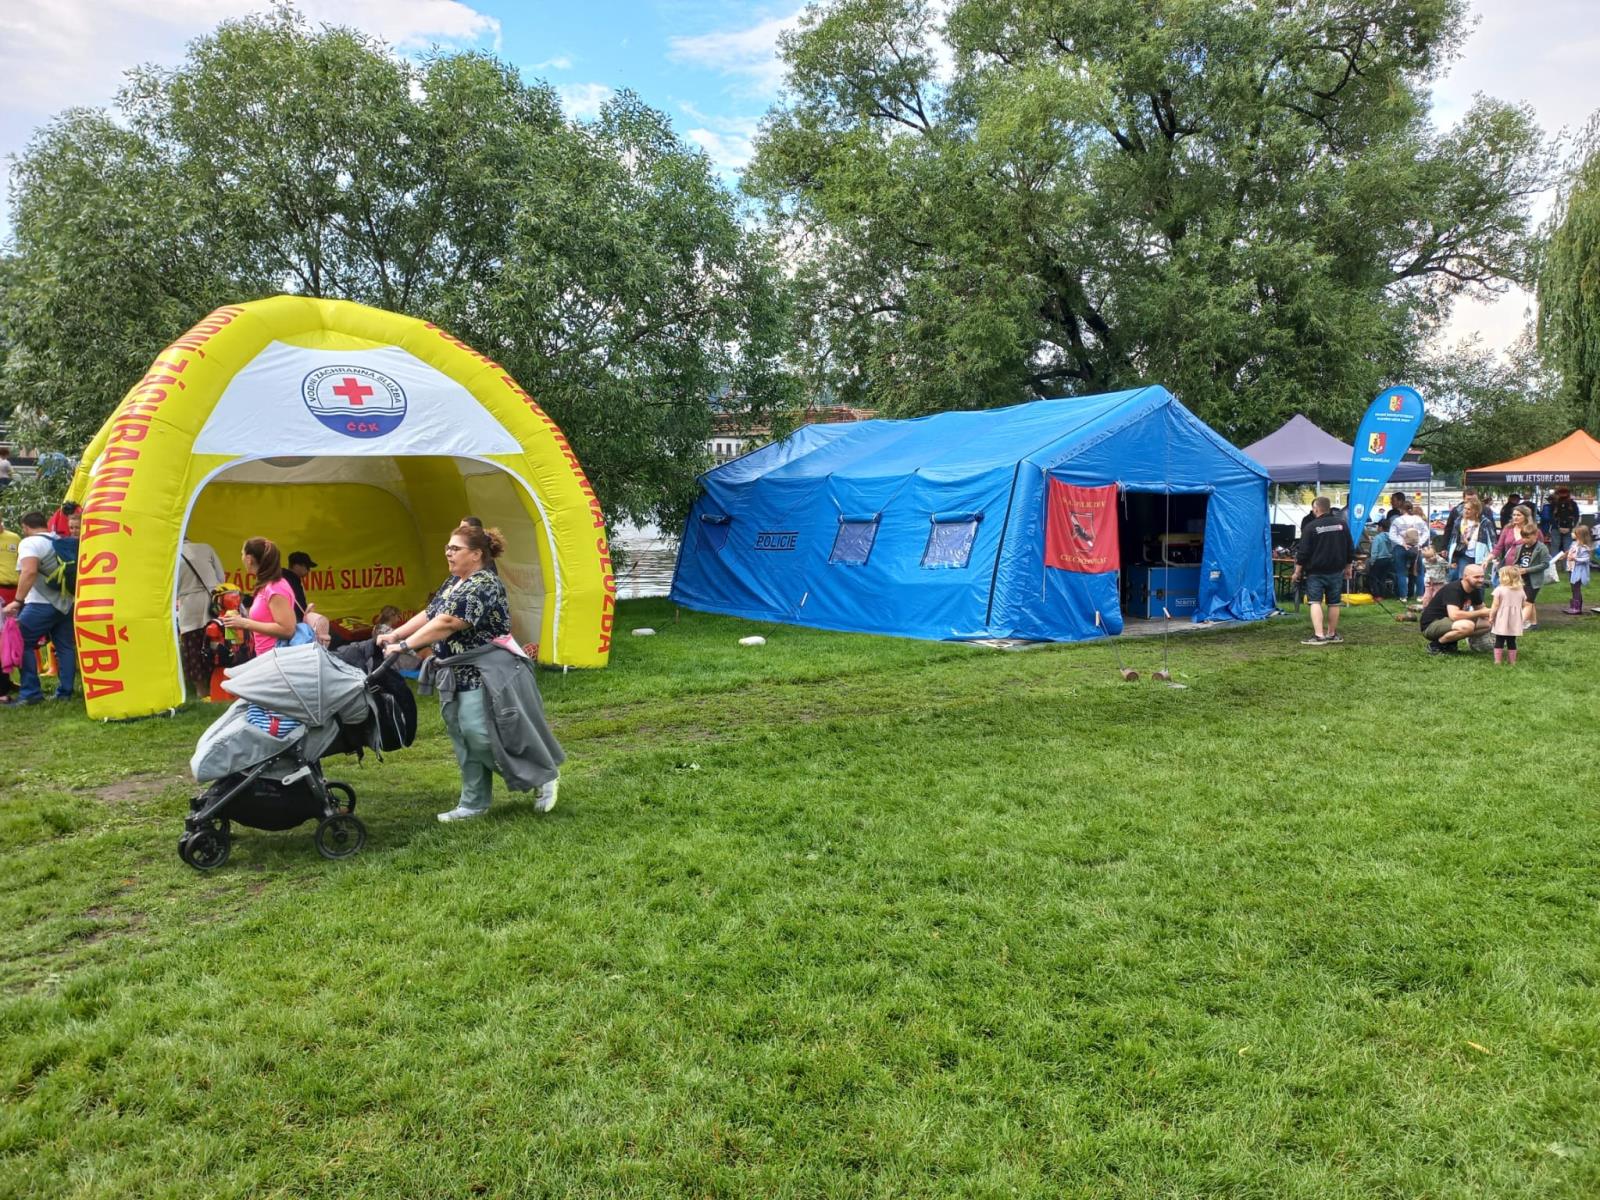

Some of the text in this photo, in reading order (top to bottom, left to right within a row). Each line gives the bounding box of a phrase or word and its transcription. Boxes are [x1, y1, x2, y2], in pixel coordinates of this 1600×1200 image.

[82, 359, 188, 543] ZÁCHRANNÁ
[1505, 474, 1570, 483] WWW.JETSURF.COM
[756, 535, 798, 548] POLICIE
[224, 563, 405, 592] ZÁCNNÁ SLUŽBA
[74, 551, 129, 701] SLUŽBA
